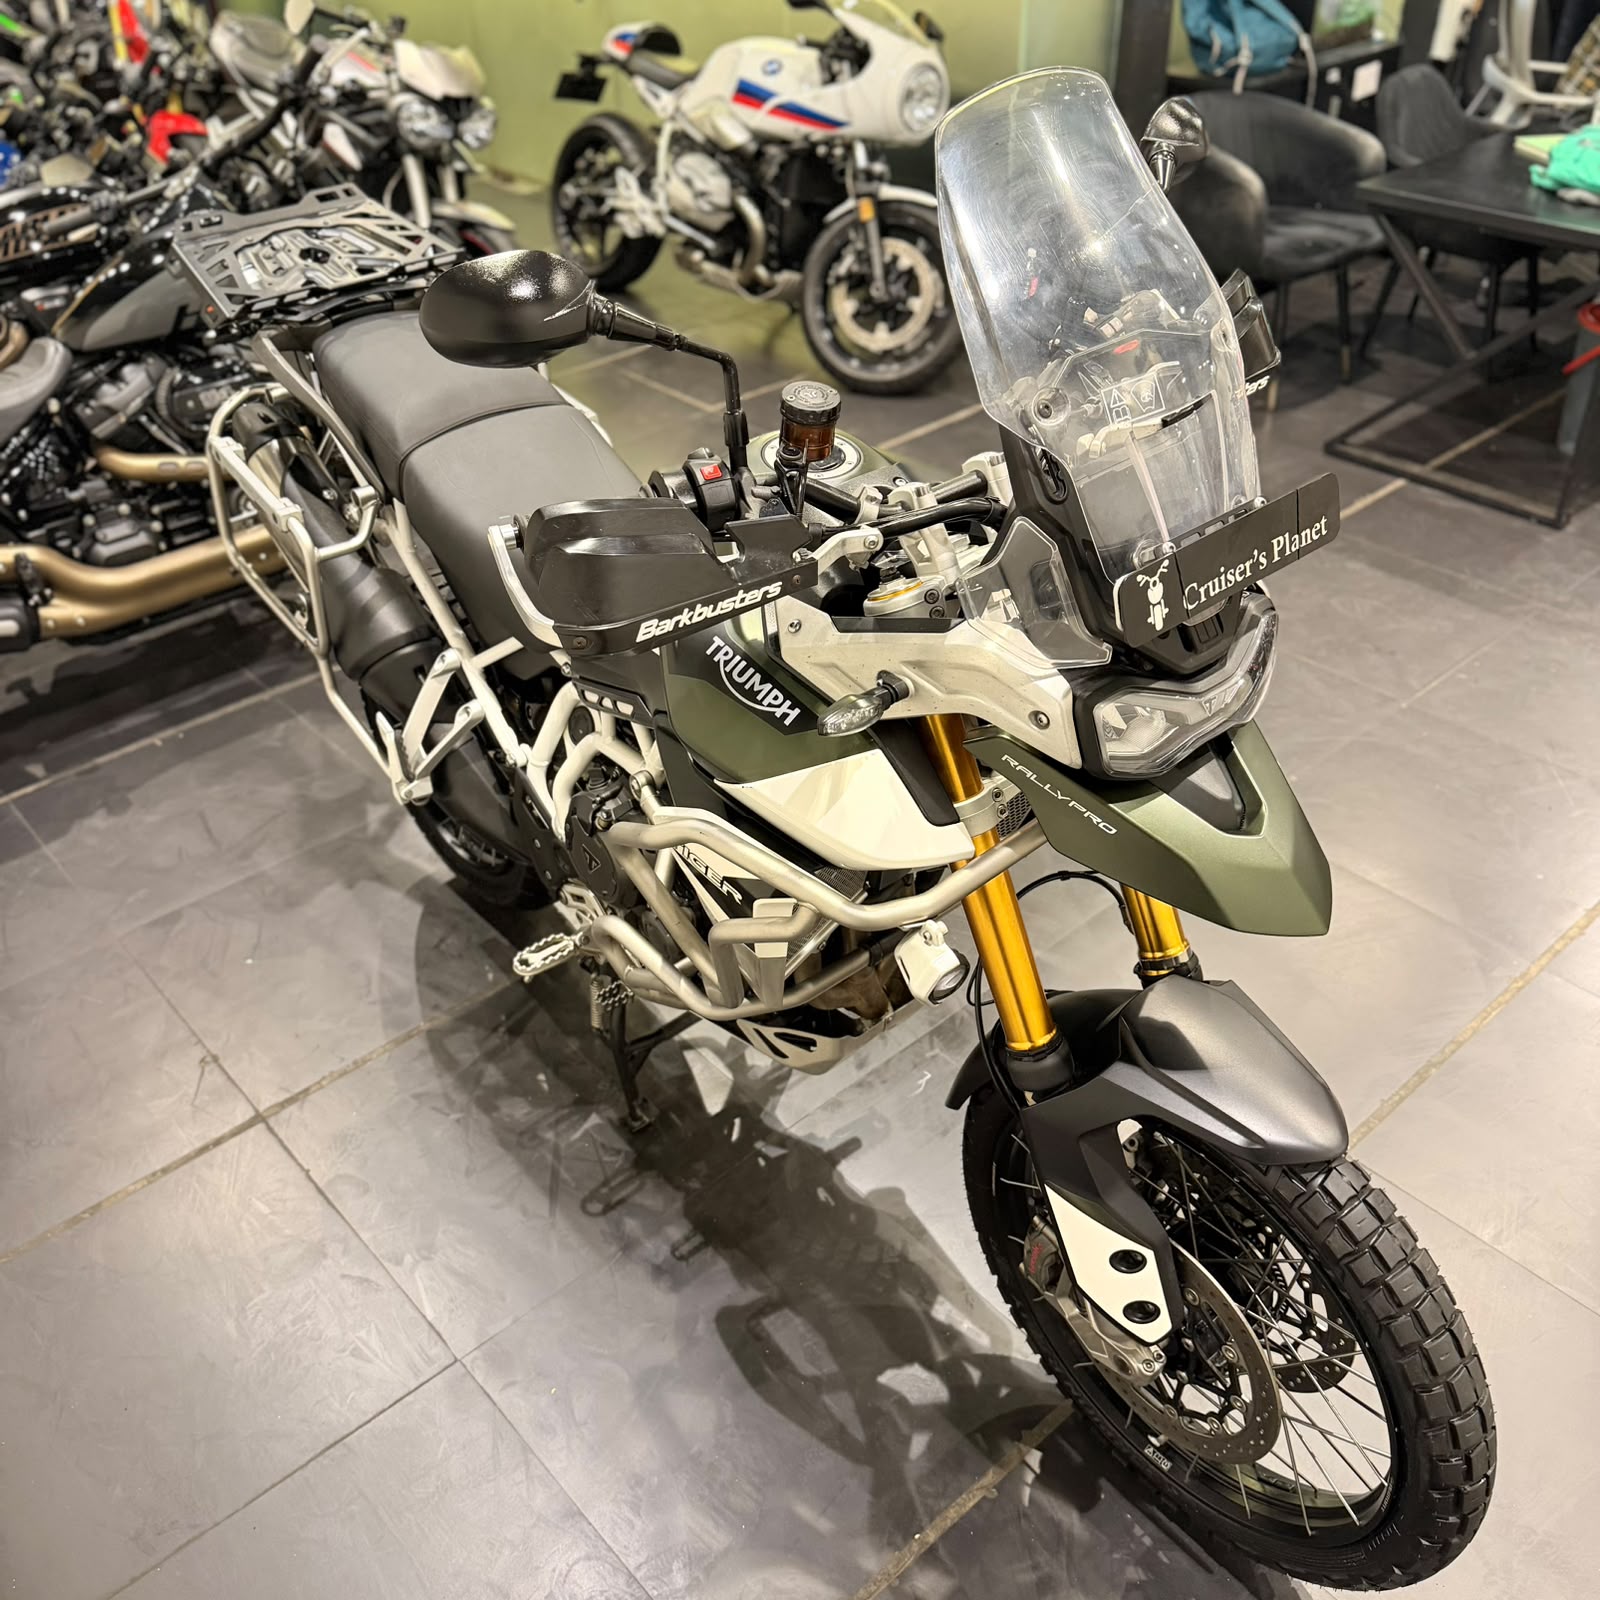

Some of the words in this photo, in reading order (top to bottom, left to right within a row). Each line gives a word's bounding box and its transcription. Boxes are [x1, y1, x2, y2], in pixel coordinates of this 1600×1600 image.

[1183, 549, 1268, 611] Cruiser's
[1271, 515, 1328, 563] Planet
[635, 581, 783, 643] Barkbusters
[705, 635, 801, 726] TRIUMPH
